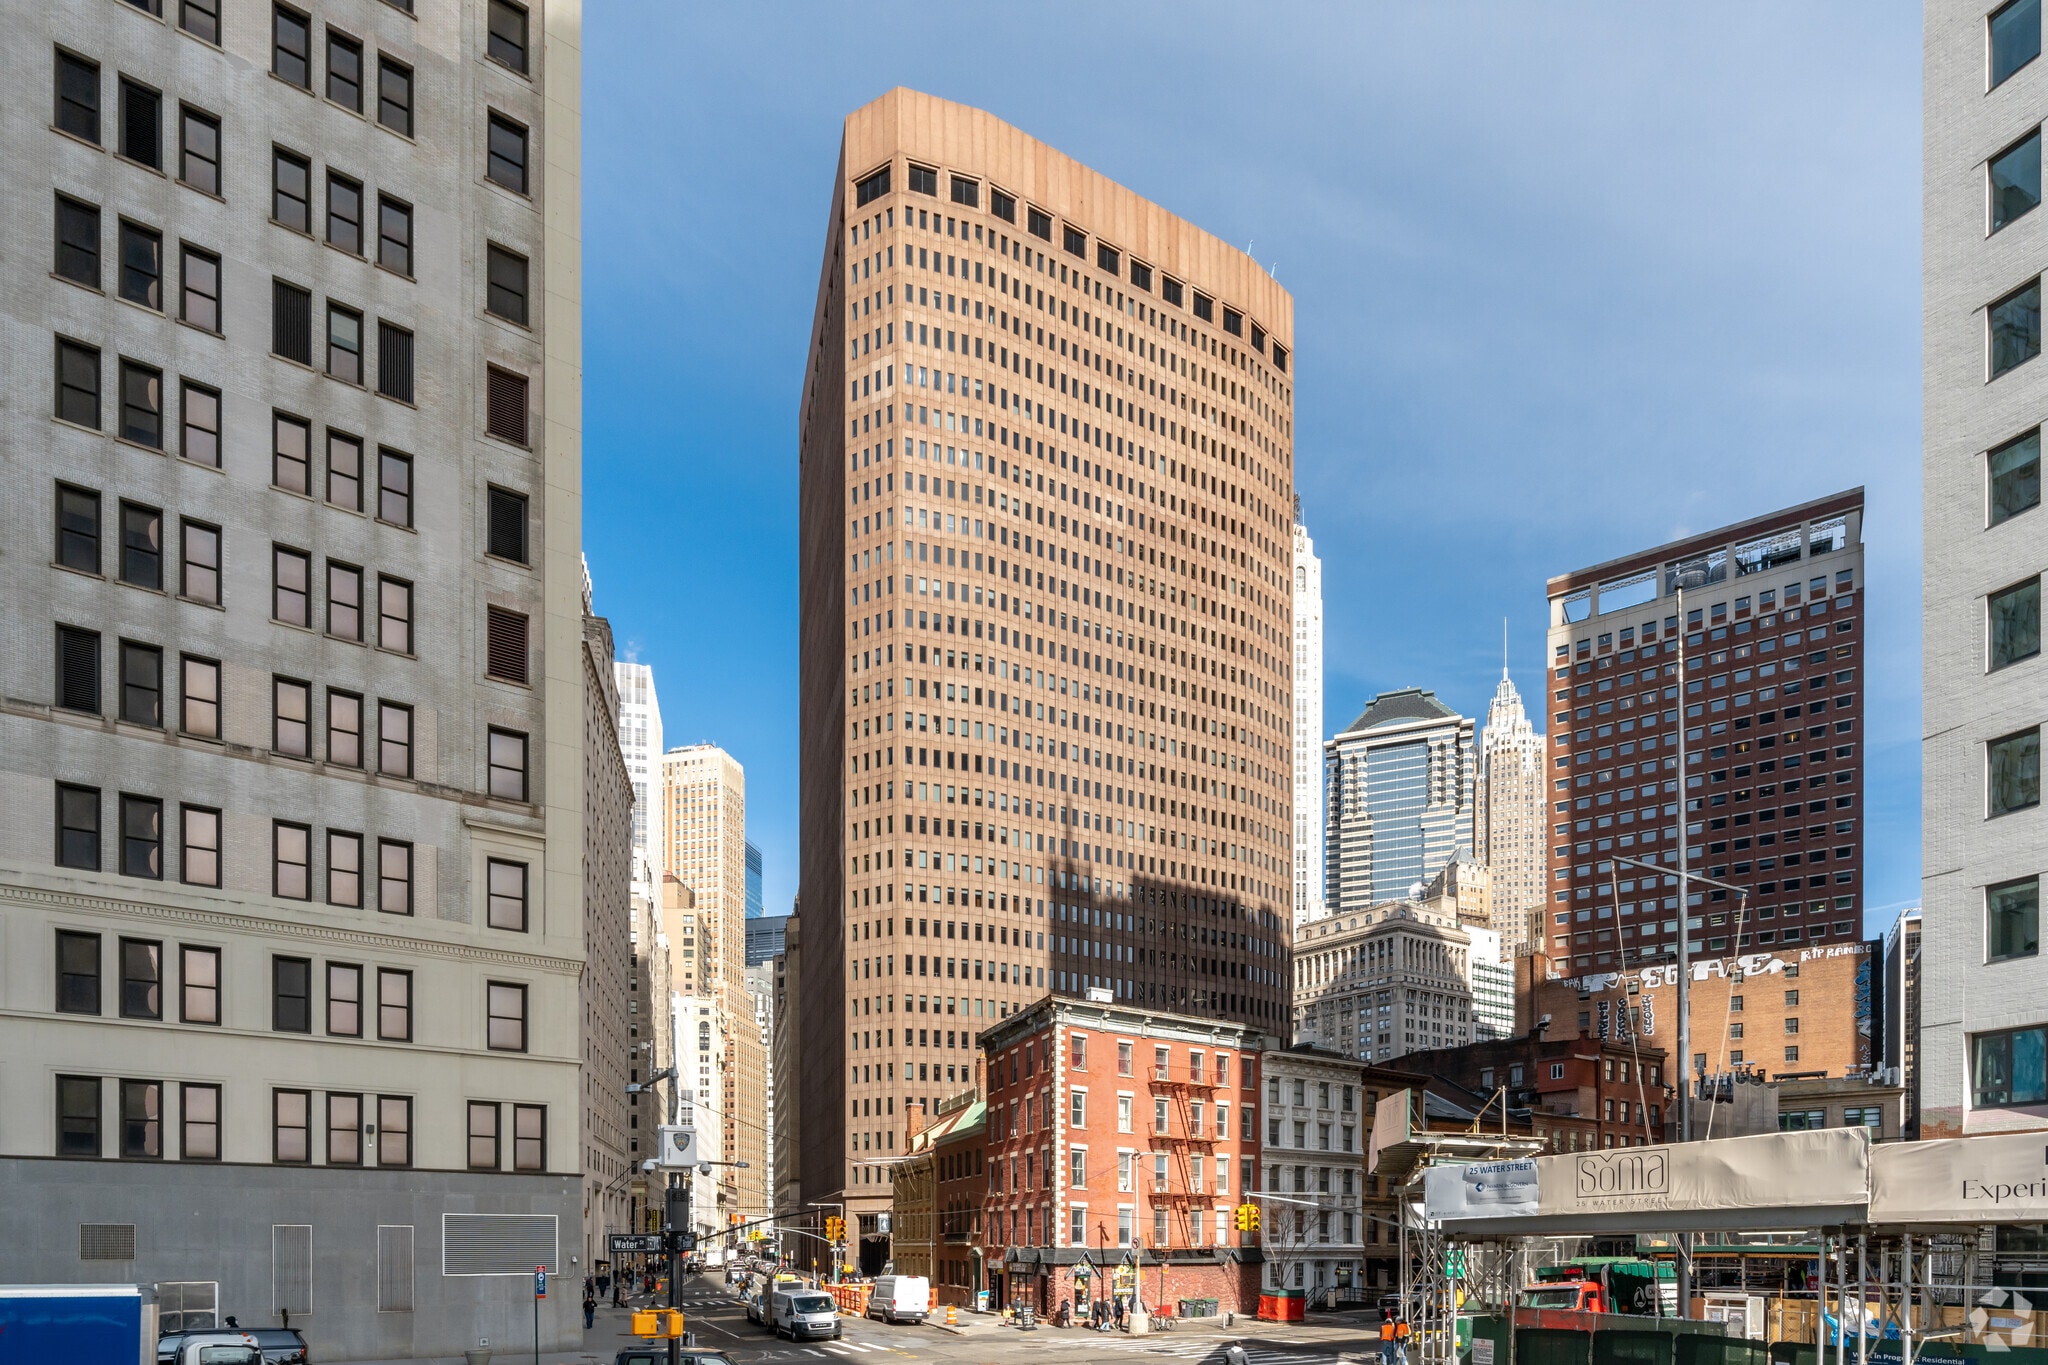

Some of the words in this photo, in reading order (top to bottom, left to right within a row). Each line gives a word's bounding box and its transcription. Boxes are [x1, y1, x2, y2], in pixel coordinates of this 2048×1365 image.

[1800, 947, 1824, 962] RIP
[1469, 1167, 1478, 1175] 25
[1480, 1164, 1506, 1174] WATER
[1506, 1162, 1533, 1172] STREET
[1963, 1178, 2046, 1204] Experi
[1630, 1196, 1669, 1205] STREET
[614, 1239, 639, 1249] Water
[1874, 1352, 1882, 1360] in
[1921, 1356, 1965, 1365] Residential
